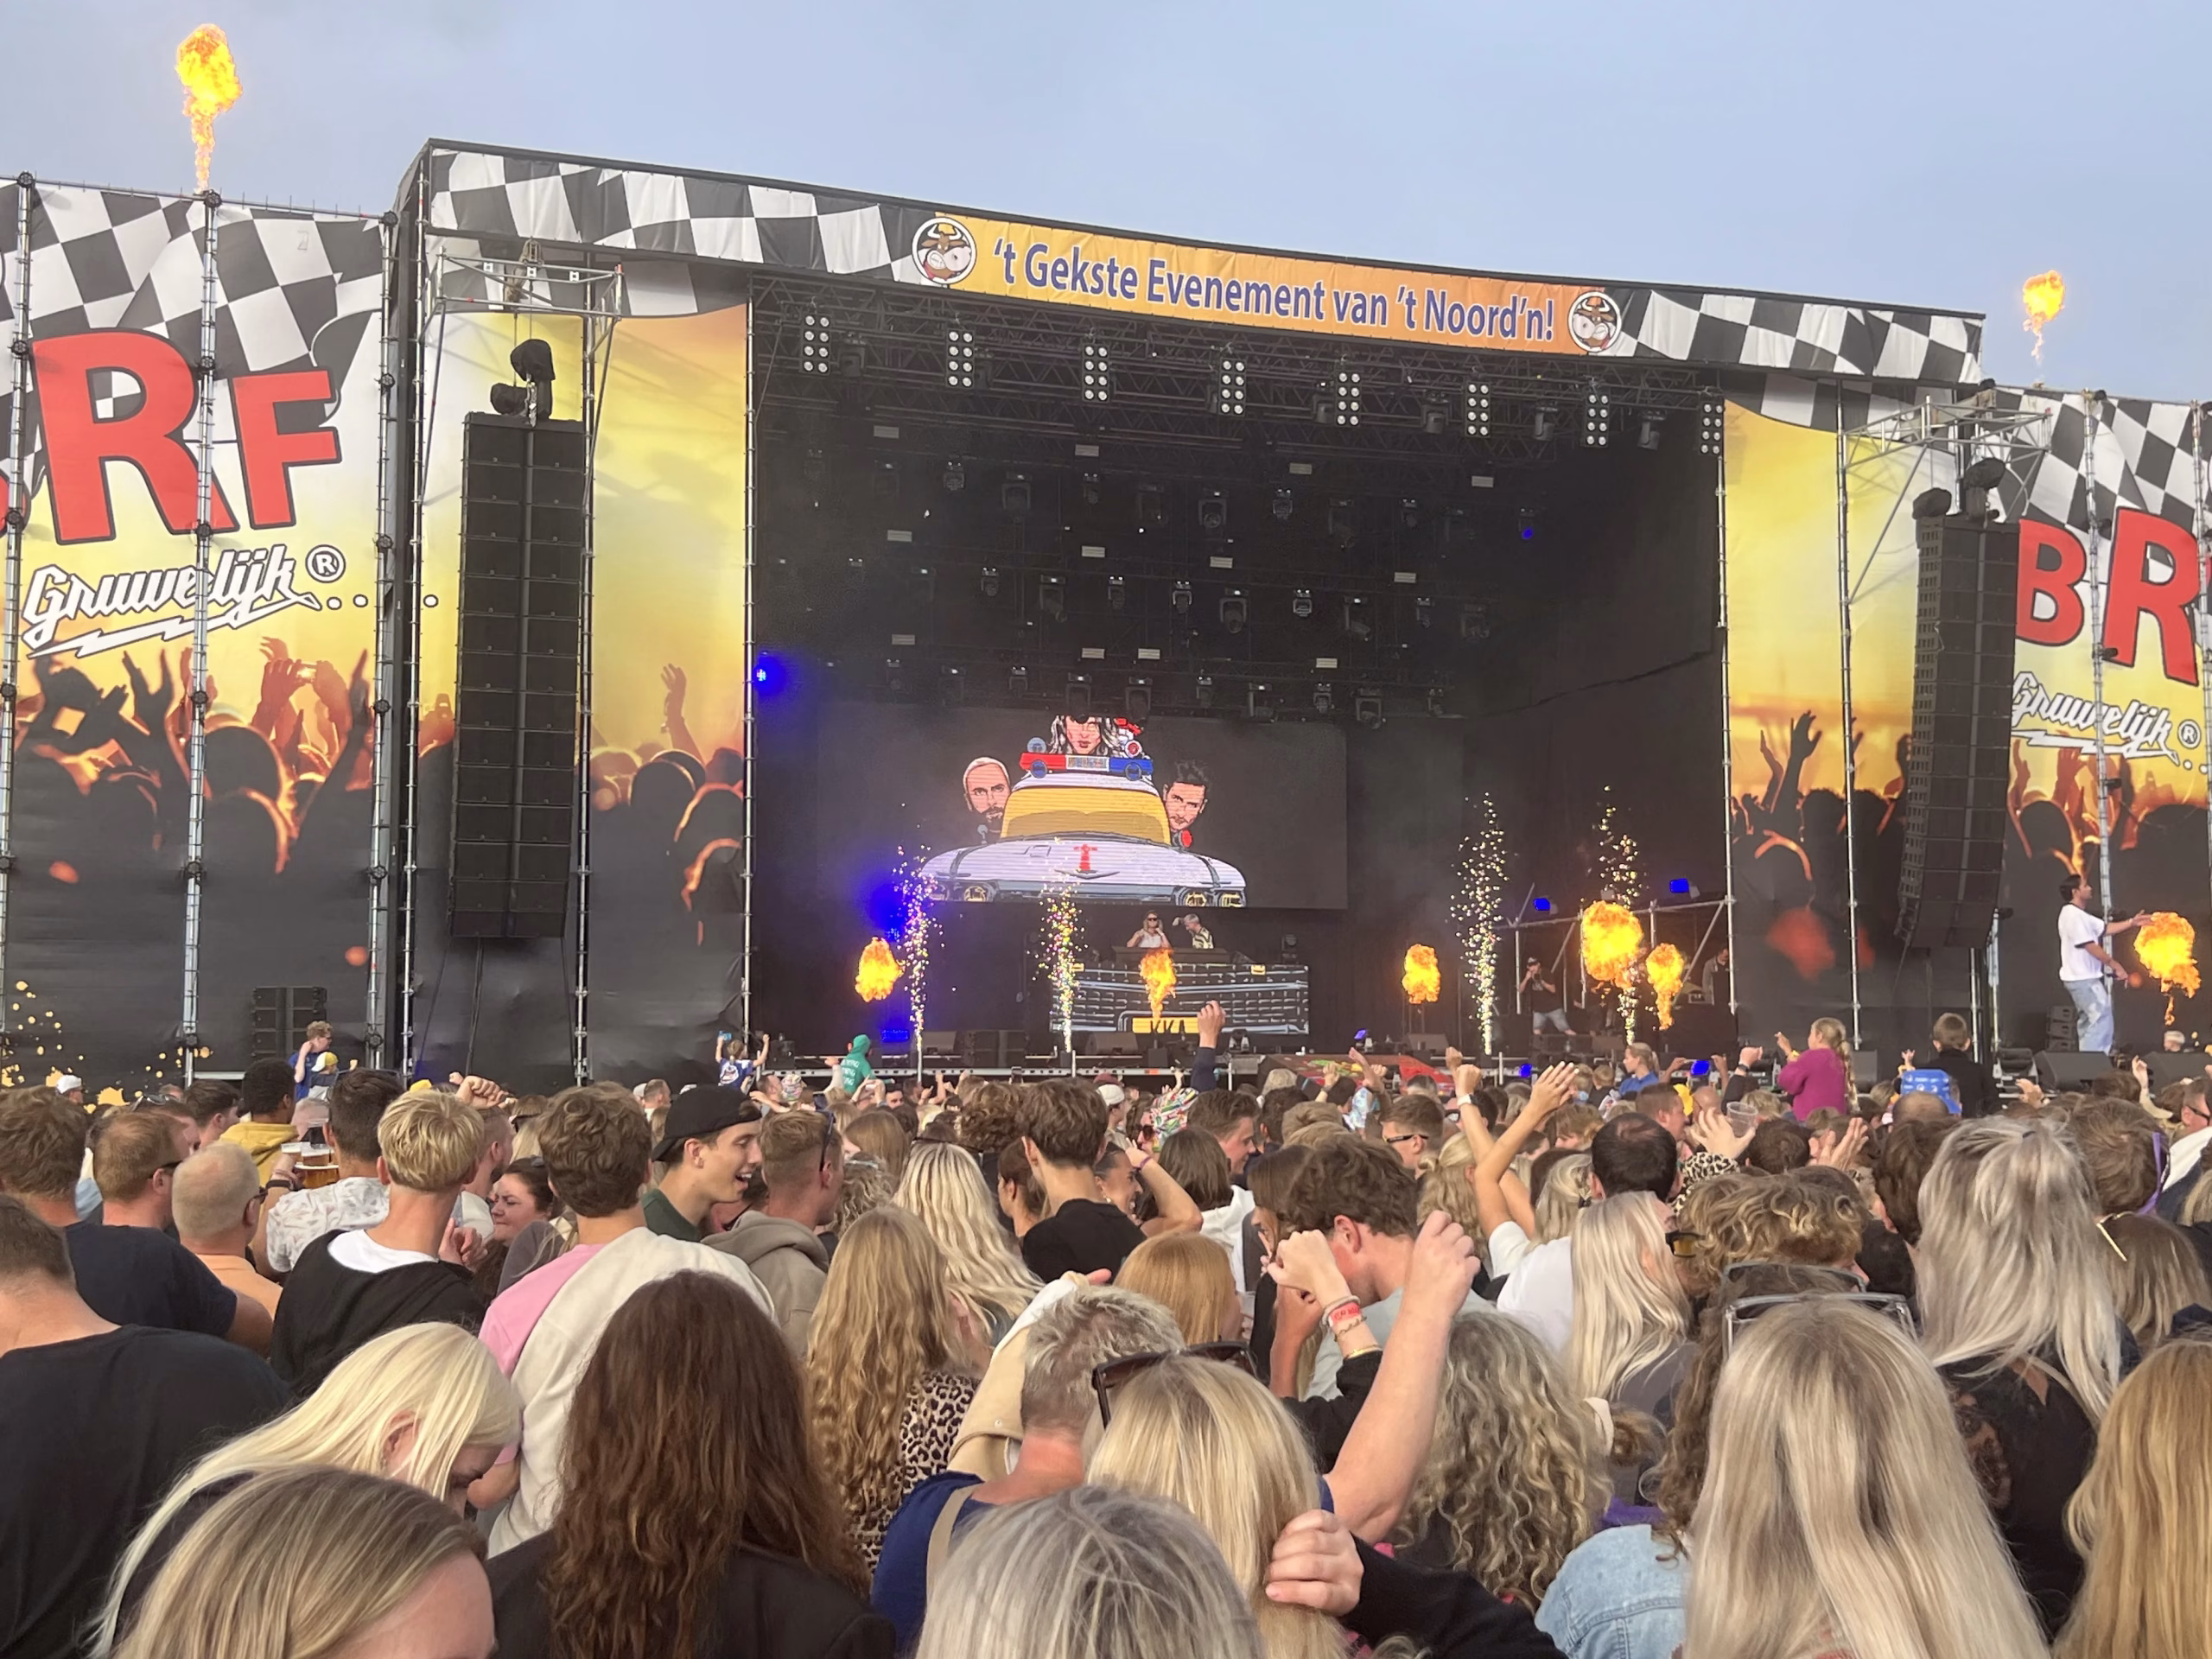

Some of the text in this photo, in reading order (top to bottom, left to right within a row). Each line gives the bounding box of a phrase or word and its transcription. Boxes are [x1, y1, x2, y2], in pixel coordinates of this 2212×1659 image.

[1026, 244, 1138, 299] Gekste
[1147, 259, 1325, 320] Evenement
[1334, 290, 1388, 325] van
[1425, 289, 1554, 340] Noord'n!
[0, 328, 342, 545] RF
[22, 544, 322, 652] Gruwelijk
